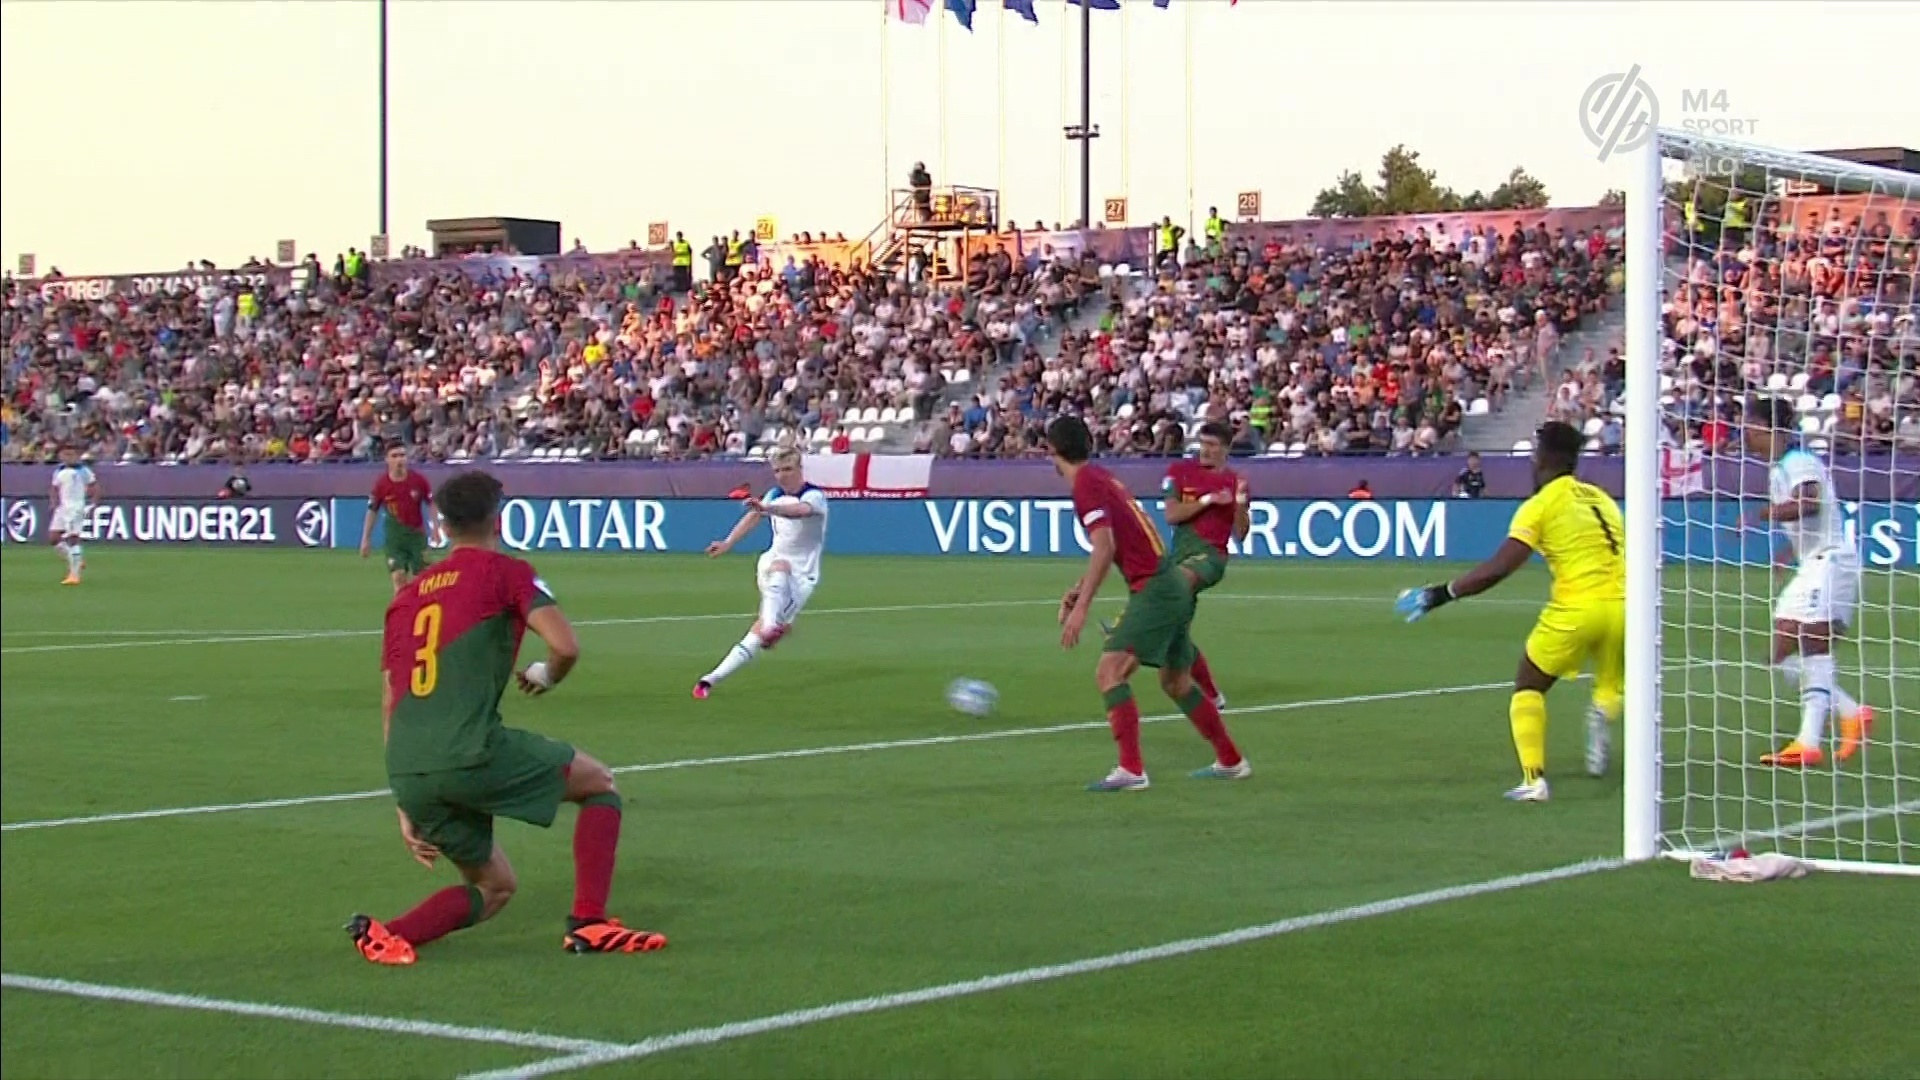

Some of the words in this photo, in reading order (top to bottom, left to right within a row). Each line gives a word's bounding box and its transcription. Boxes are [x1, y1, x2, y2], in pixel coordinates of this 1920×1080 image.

[1107, 201, 1123, 216] 27
[1239, 194, 1256, 209] 28
[81, 505, 129, 540] EFA
[134, 505, 276, 540] UNDER21
[500, 499, 666, 551] QATAR
[410, 602, 443, 698] 3
